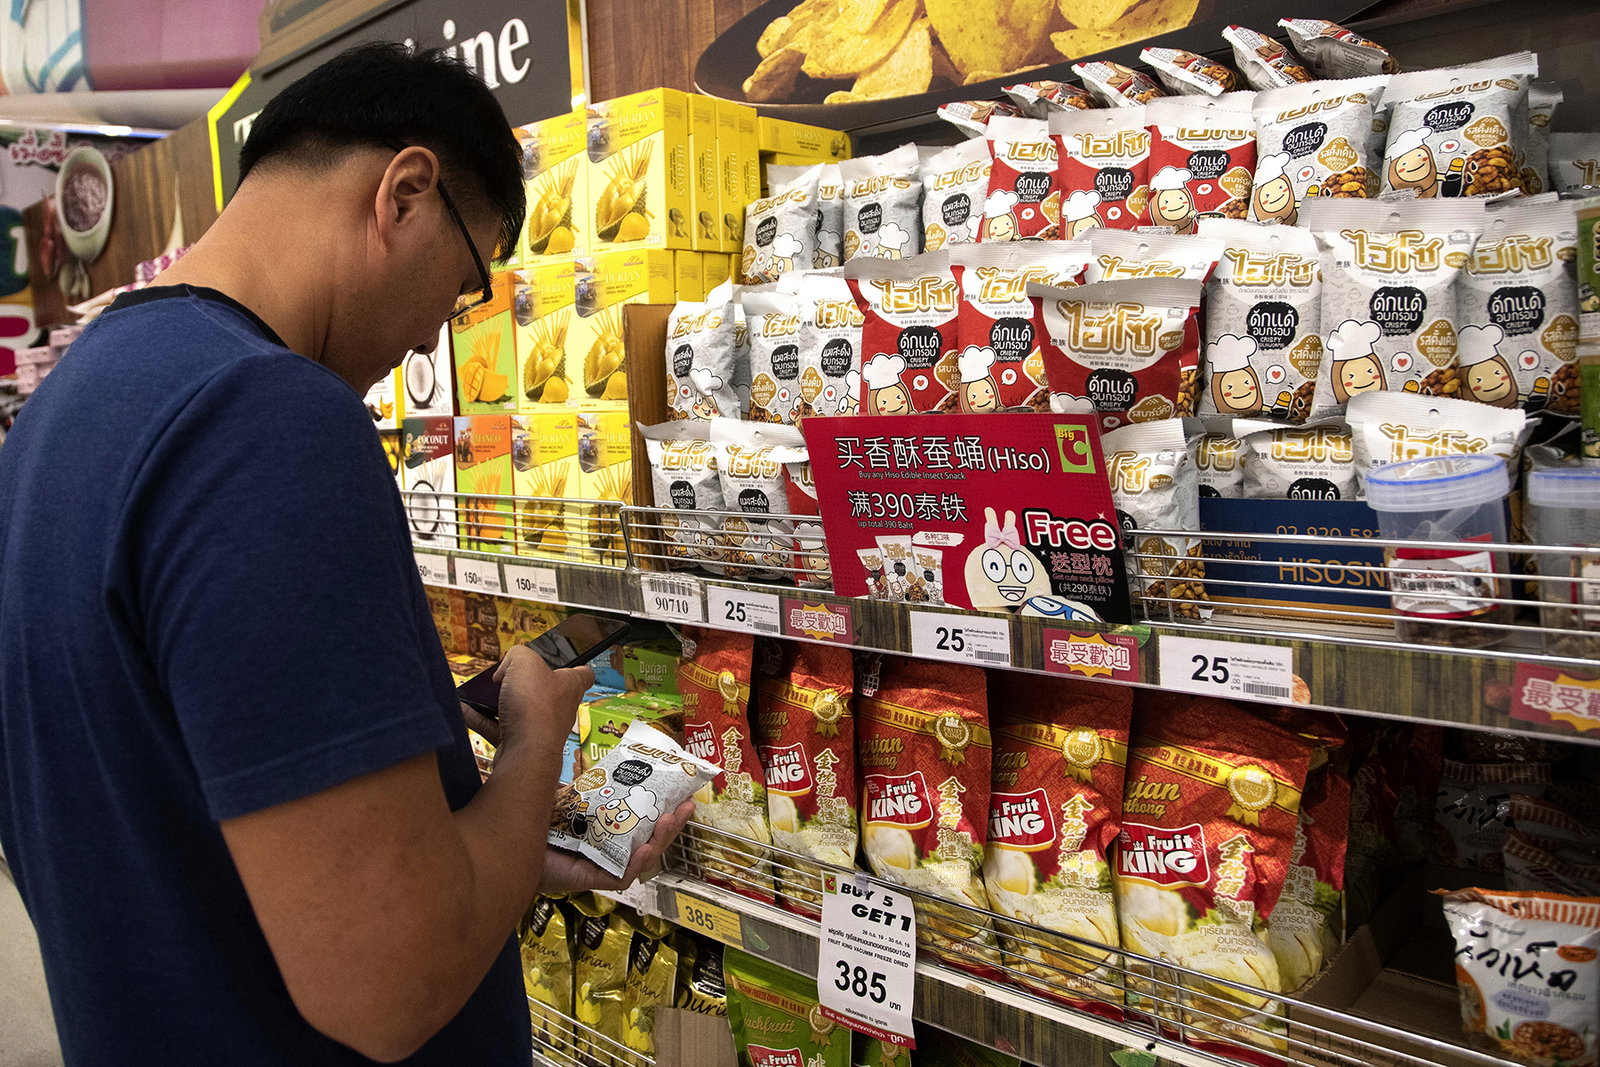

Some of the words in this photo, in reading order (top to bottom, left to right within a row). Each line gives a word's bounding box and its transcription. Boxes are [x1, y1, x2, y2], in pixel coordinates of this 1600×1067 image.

[1427, 103, 1471, 121] ดักแด้
[1286, 123, 1325, 146] ดักแด้
[1466, 123, 1506, 137] รสดั้งเดิม
[1074, 130, 1149, 158] ไฮโซ
[1288, 137, 1320, 150] อบกรอบ
[1320, 144, 1356, 160] รสดั้งเดิม
[1189, 153, 1227, 167] ดักแด้
[1191, 164, 1223, 172] อบกรอบ
[1017, 174, 1050, 190] ดักแด้
[1097, 171, 1132, 187] ดักแด้
[1099, 184, 1129, 192] อบกรอบ
[1018, 187, 1046, 196] อบกรอบ
[1340, 229, 1444, 274] ไฮโซ
[1225, 248, 1319, 287] ไฮโซ
[871, 277, 958, 313] ไฮโซ
[1373, 294, 1423, 314] ดักแด้
[1491, 294, 1542, 315] ดักแด้
[1250, 308, 1295, 328] ดักแด้
[1376, 310, 1418, 322] อบกรอบ
[1384, 321, 1410, 329] CRISPY
[1495, 310, 1538, 322] อบกรอบ
[992, 324, 1032, 342] ดักแด้
[1057, 301, 1162, 355] ไฮโซ
[1252, 325, 1291, 337] อบกรอบ
[900, 331, 940, 349] ดักแด้
[994, 340, 1028, 351] อบกรอบ
[1420, 331, 1457, 346] รสดั้งเดิม
[903, 345, 936, 357] อบกรอบ
[1089, 375, 1135, 395] ดักแด้
[1092, 391, 1131, 402] อบกรอบ
[417, 434, 448, 445] COCONUT
[475, 433, 501, 443] MANGO
[1057, 429, 1075, 441] Big
[834, 435, 1051, 474] 买香酥蚕蛹(Hiso)
[858, 470, 871, 480] Buy
[872, 470, 883, 480] any
[885, 470, 900, 480] Hiso
[901, 470, 921, 480] Edible
[923, 470, 944, 480] Insect
[946, 470, 966, 480] Snack
[847, 489, 969, 522] 满390泰铁
[868, 520, 883, 528] total
[884, 521, 896, 529] 390
[898, 521, 914, 529] Baht
[1024, 511, 1116, 550] Free
[418, 566, 429, 577] 50
[464, 572, 477, 585] 150
[1095, 576, 1115, 584] pillow
[1278, 557, 1386, 587] HISOSN
[516, 577, 530, 591] 150
[1059, 582, 1112, 597] (共290泰铁)
[655, 596, 689, 615] 90710
[725, 600, 746, 623] 25
[790, 609, 847, 635] 最受歡迎
[935, 626, 965, 652] 25
[1051, 640, 1130, 671] 最受歡迎
[640, 661, 667, 674] Durian
[1191, 655, 1229, 684] 25
[693, 729, 713, 744] Fruit
[1072, 741, 1094, 751] FRUIT
[1072, 749, 1091, 757] KING
[773, 750, 800, 766] Fruit
[814, 748, 840, 797] 金枕頭
[885, 780, 917, 798] Fruit
[1239, 780, 1265, 793] FRUIT
[1242, 787, 1263, 799] KING
[871, 794, 923, 819] KING
[1002, 798, 1039, 816] Fruit
[1062, 794, 1095, 851] 金枕頭
[938, 829, 958, 859] 榴槤
[1147, 834, 1195, 850] Fruit
[1122, 850, 1197, 874] KING
[1214, 834, 1255, 897] 金枕頭
[841, 883, 875, 901] BUY
[882, 896, 894, 907] 5
[685, 905, 714, 931] 385
[852, 904, 896, 926] GET
[901, 915, 912, 932] 1
[577, 952, 614, 972] urian
[828, 938, 841, 946] FRUIT
[874, 953, 892, 963] FREEZE
[894, 960, 908, 968] DRIED
[835, 960, 886, 1003] 385
[680, 984, 727, 1016] Duri
[889, 1001, 901, 1011] บาท
[768, 1054, 797, 1066] Fruit
